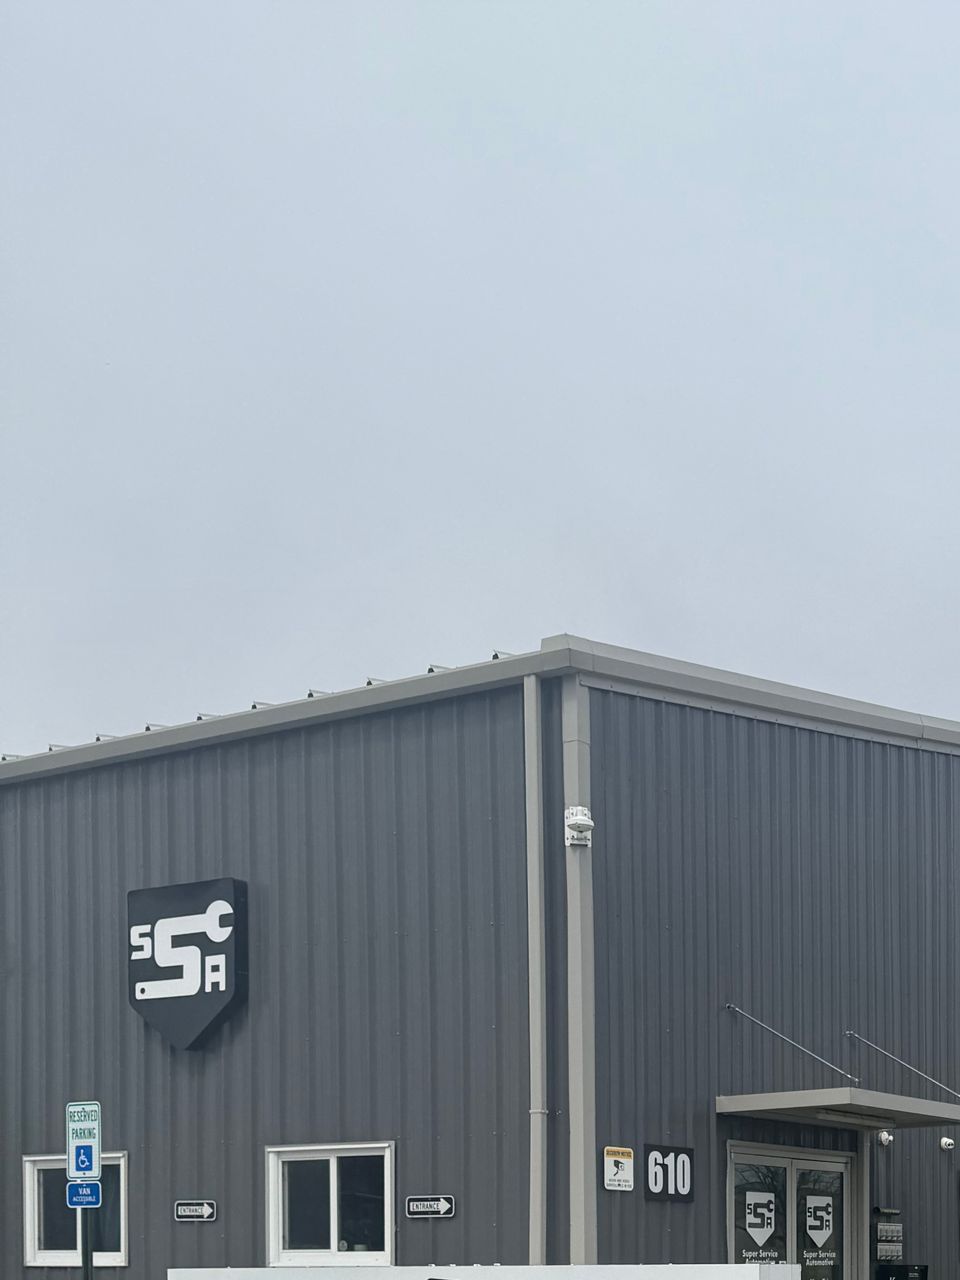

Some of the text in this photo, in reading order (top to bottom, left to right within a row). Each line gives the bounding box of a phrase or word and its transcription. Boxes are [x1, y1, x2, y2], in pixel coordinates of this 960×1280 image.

[69, 1110, 98, 1122] RESERVED
[71, 1128, 96, 1140] PARKING
[648, 1150, 691, 1195] 610
[78, 1187, 91, 1195] VAN
[412, 1202, 440, 1210] ENTRANCE
[742, 1249, 778, 1259] Super Service
[803, 1250, 836, 1260] Super Service
